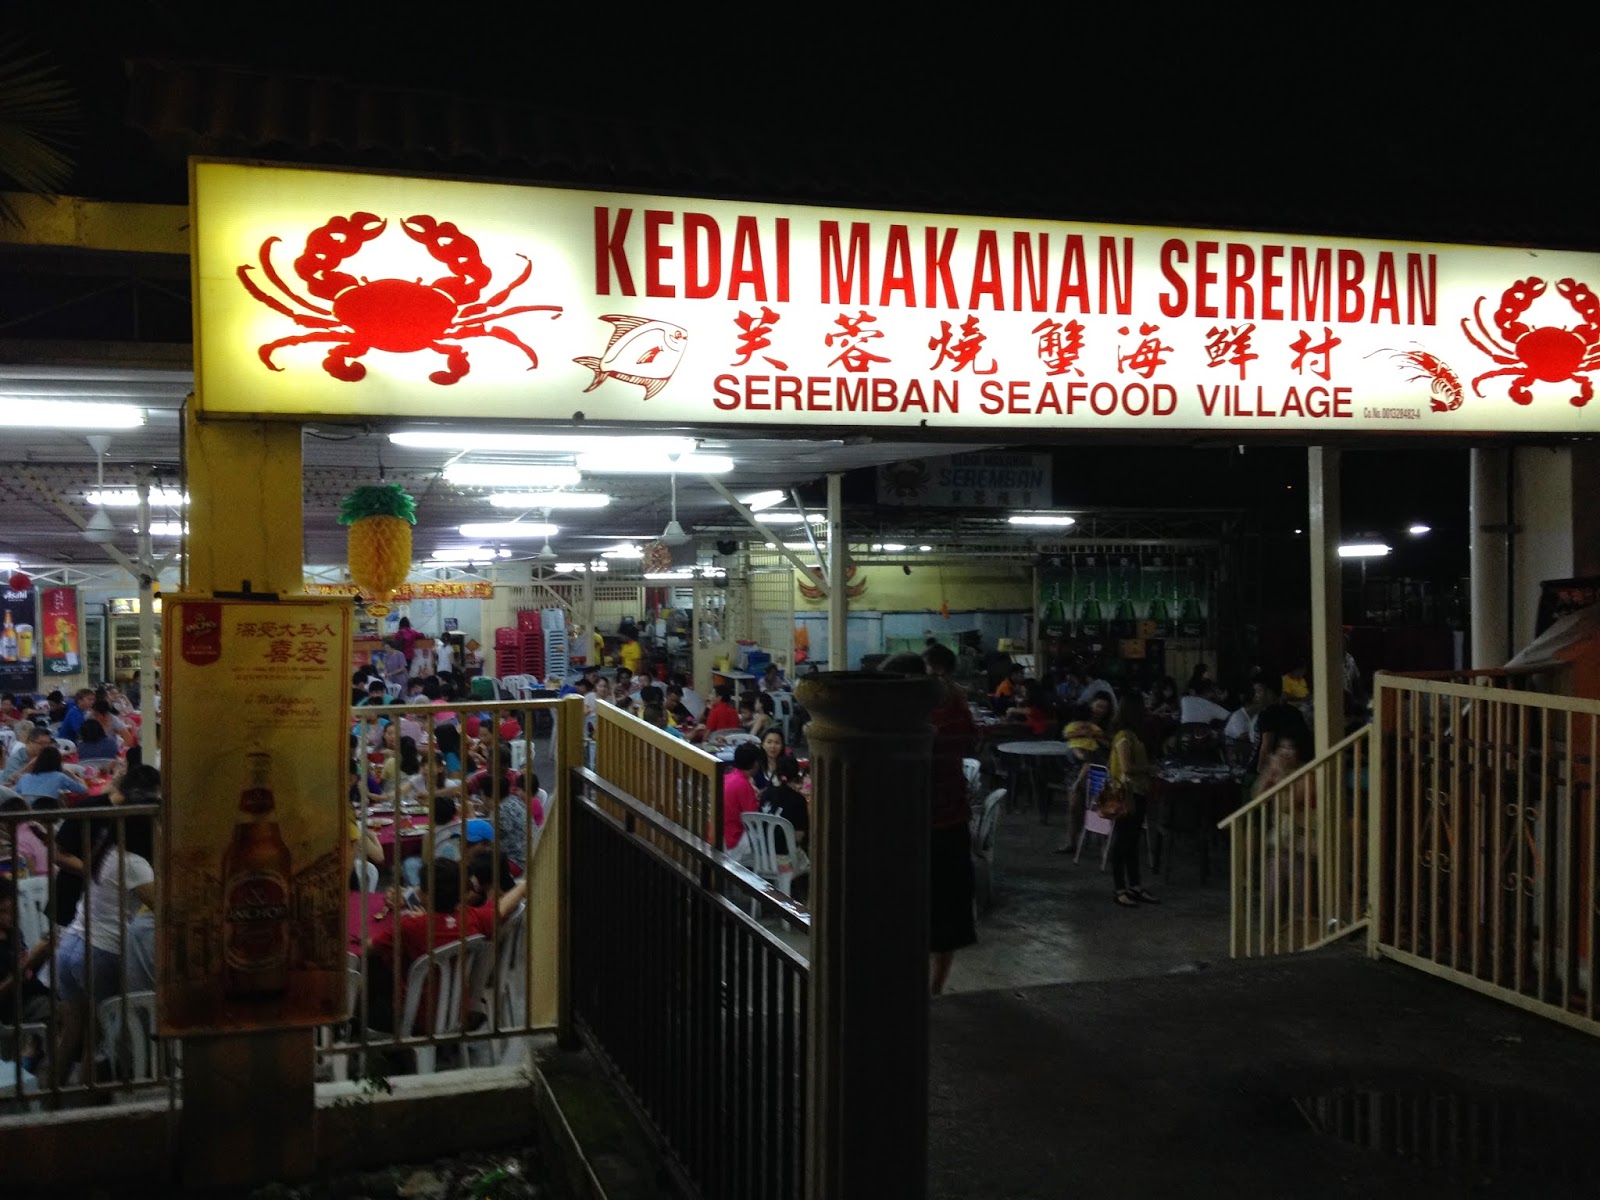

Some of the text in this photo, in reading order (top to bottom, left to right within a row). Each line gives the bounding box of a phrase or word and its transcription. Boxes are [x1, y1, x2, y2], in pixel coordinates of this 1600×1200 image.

[595, 207, 1437, 327] KEDAI MAKANAN SEREMBAN
[713, 373, 1353, 418] SEREMBAN SEAFOOD VILLAGE
[940, 468, 1043, 489] SEREMBAN
